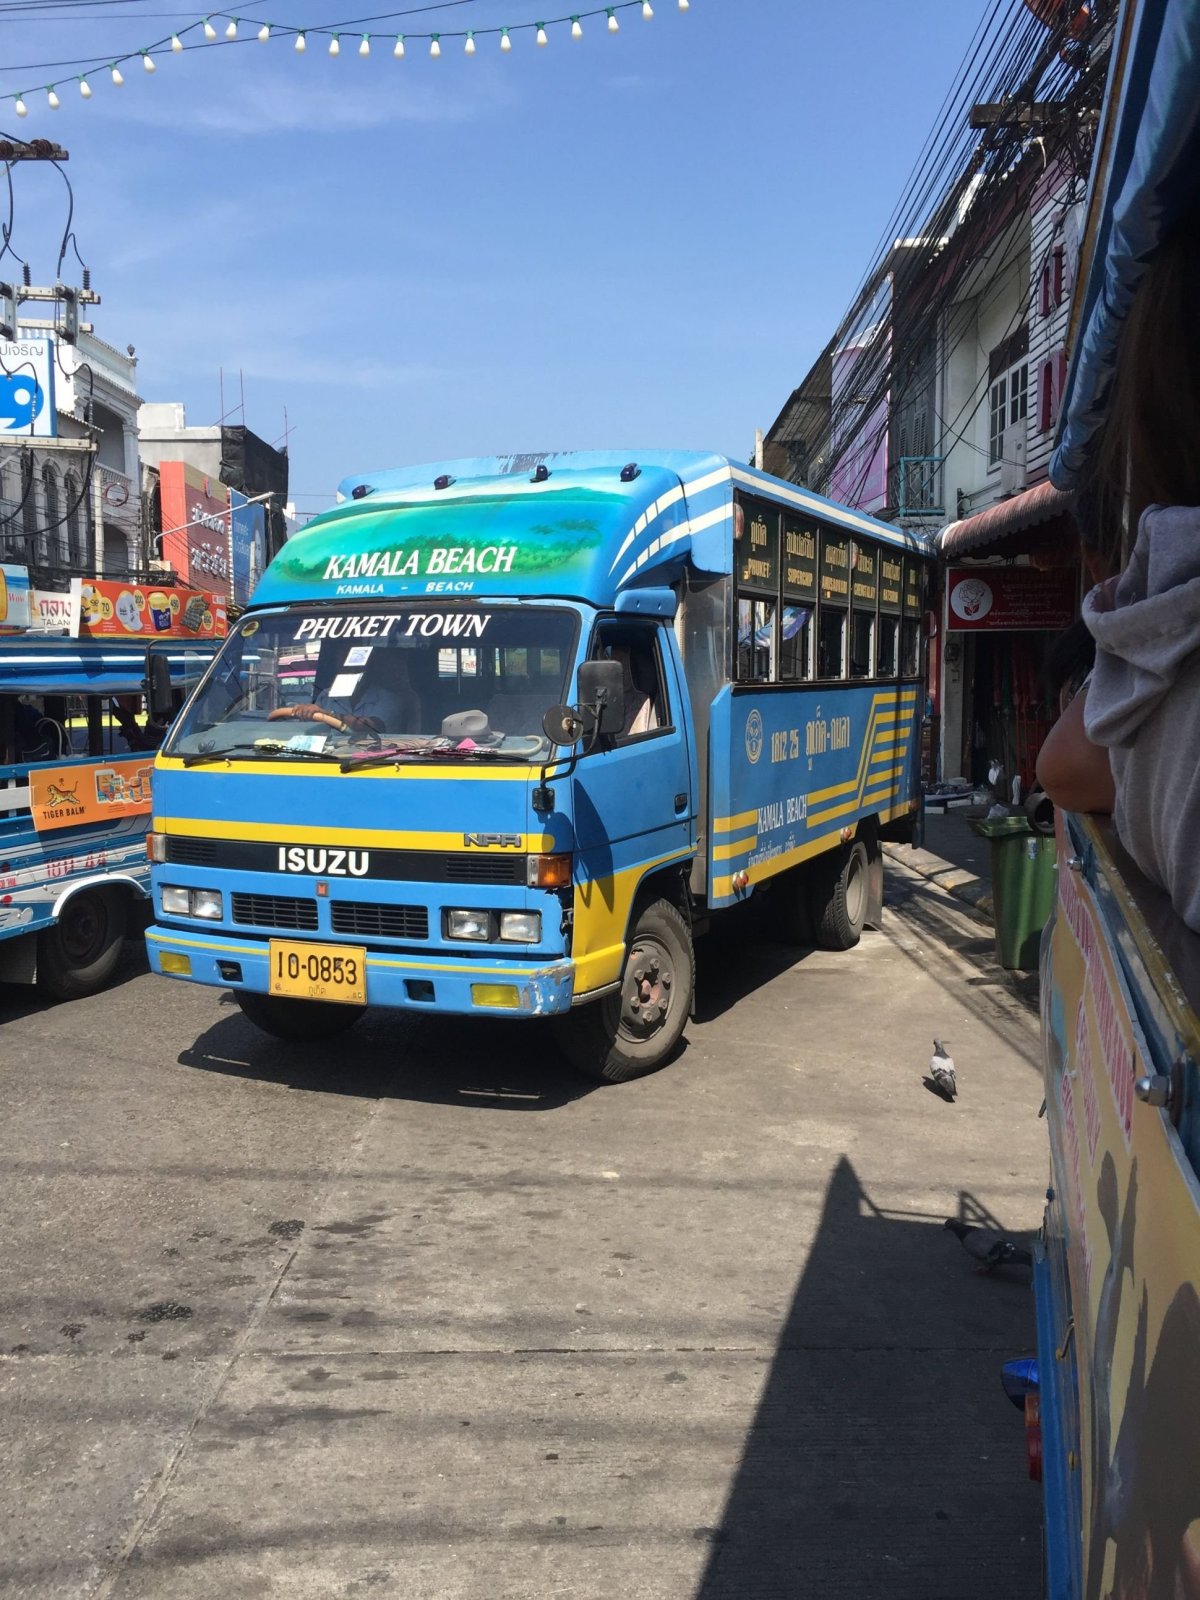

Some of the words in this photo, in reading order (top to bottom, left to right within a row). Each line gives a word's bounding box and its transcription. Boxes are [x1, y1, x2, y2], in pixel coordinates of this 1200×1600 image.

[322, 550, 420, 580] KAMALA
[425, 546, 518, 575] BEACH
[336, 583, 384, 595] KAMALA
[425, 581, 474, 593] BEACH
[293, 615, 401, 640] PHUKET
[405, 614, 491, 638] TOWN
[43, 811, 64, 820] TIGER
[66, 806, 85, 817] BALM
[757, 801, 784, 834] KAMALA
[786, 794, 807, 824] BEACH
[278, 847, 369, 876] ISUZU
[278, 951, 358, 985] 10-0853
